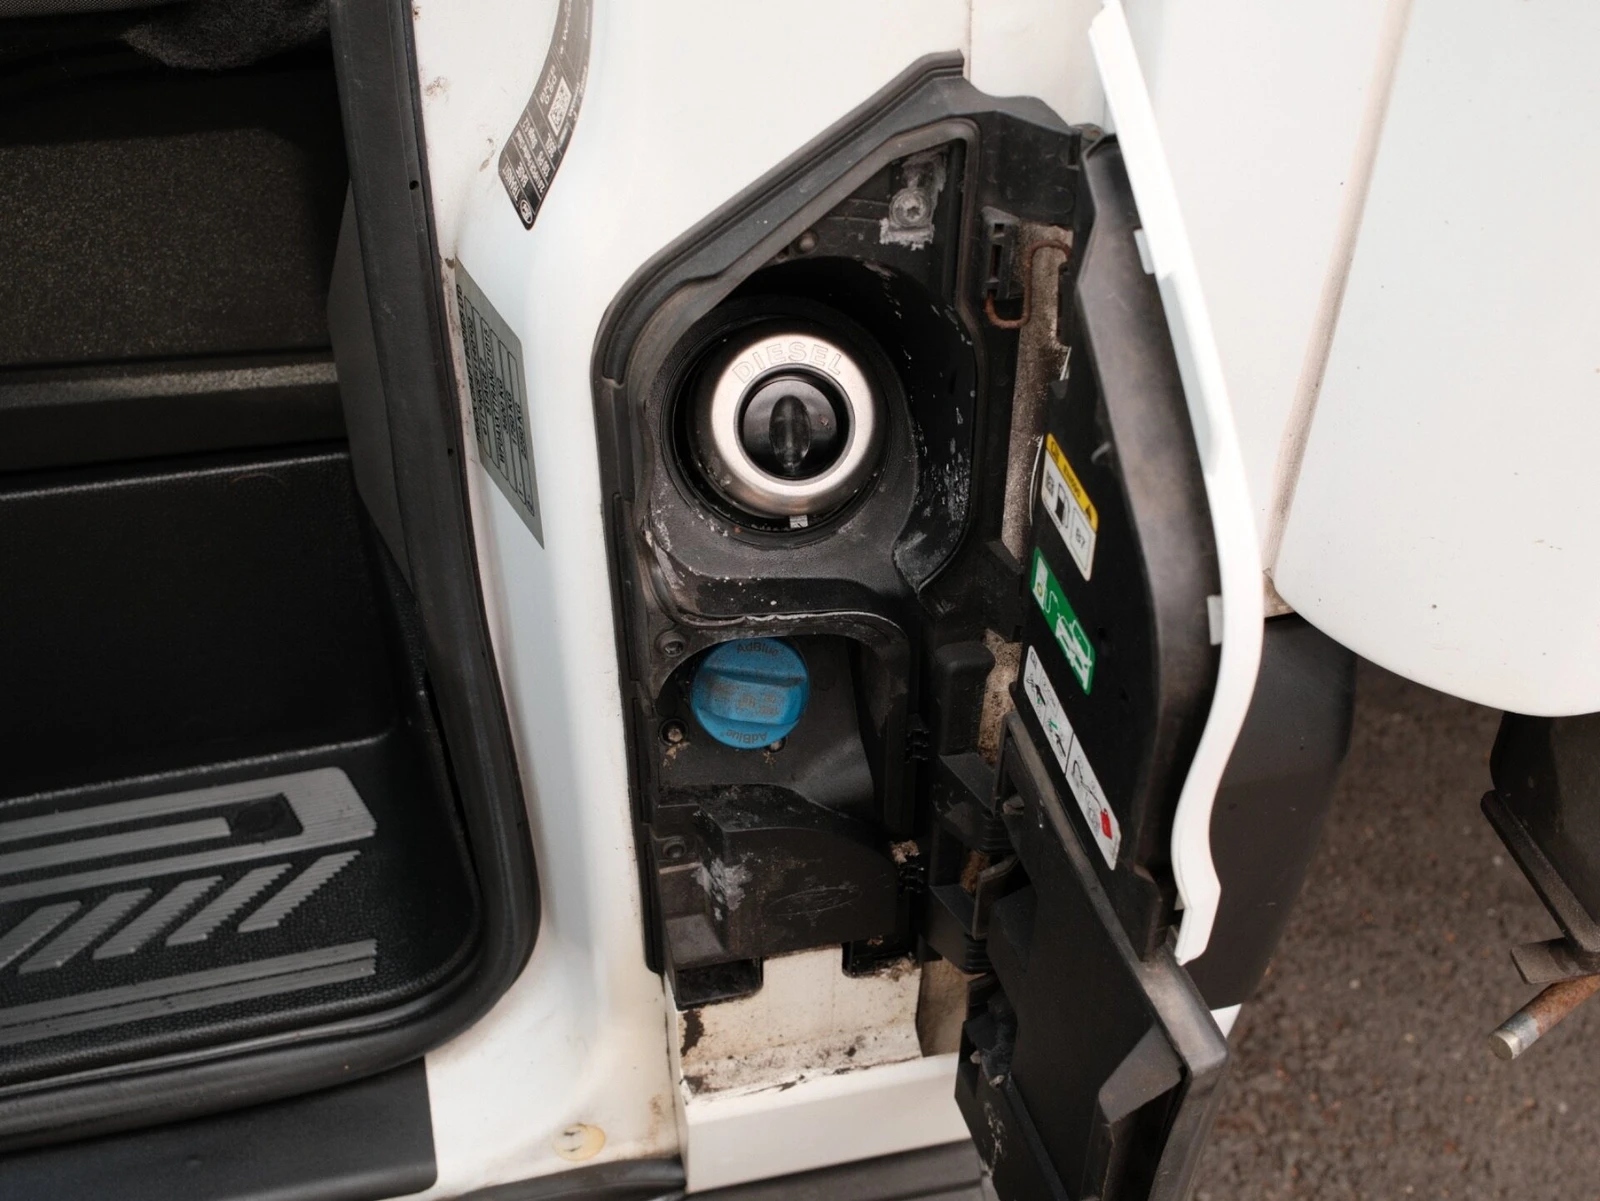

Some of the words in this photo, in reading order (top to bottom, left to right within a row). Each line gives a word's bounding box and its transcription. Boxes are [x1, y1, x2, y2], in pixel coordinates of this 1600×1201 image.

[502, 163, 520, 200] TRANSIT
[515, 160, 529, 188] BASE
[456, 284, 464, 308] LTD
[732, 341, 843, 384] DIESEL
[481, 367, 491, 418] STAGE
[736, 641, 780, 657] AdBlue
[725, 729, 768, 744] AdBlue
